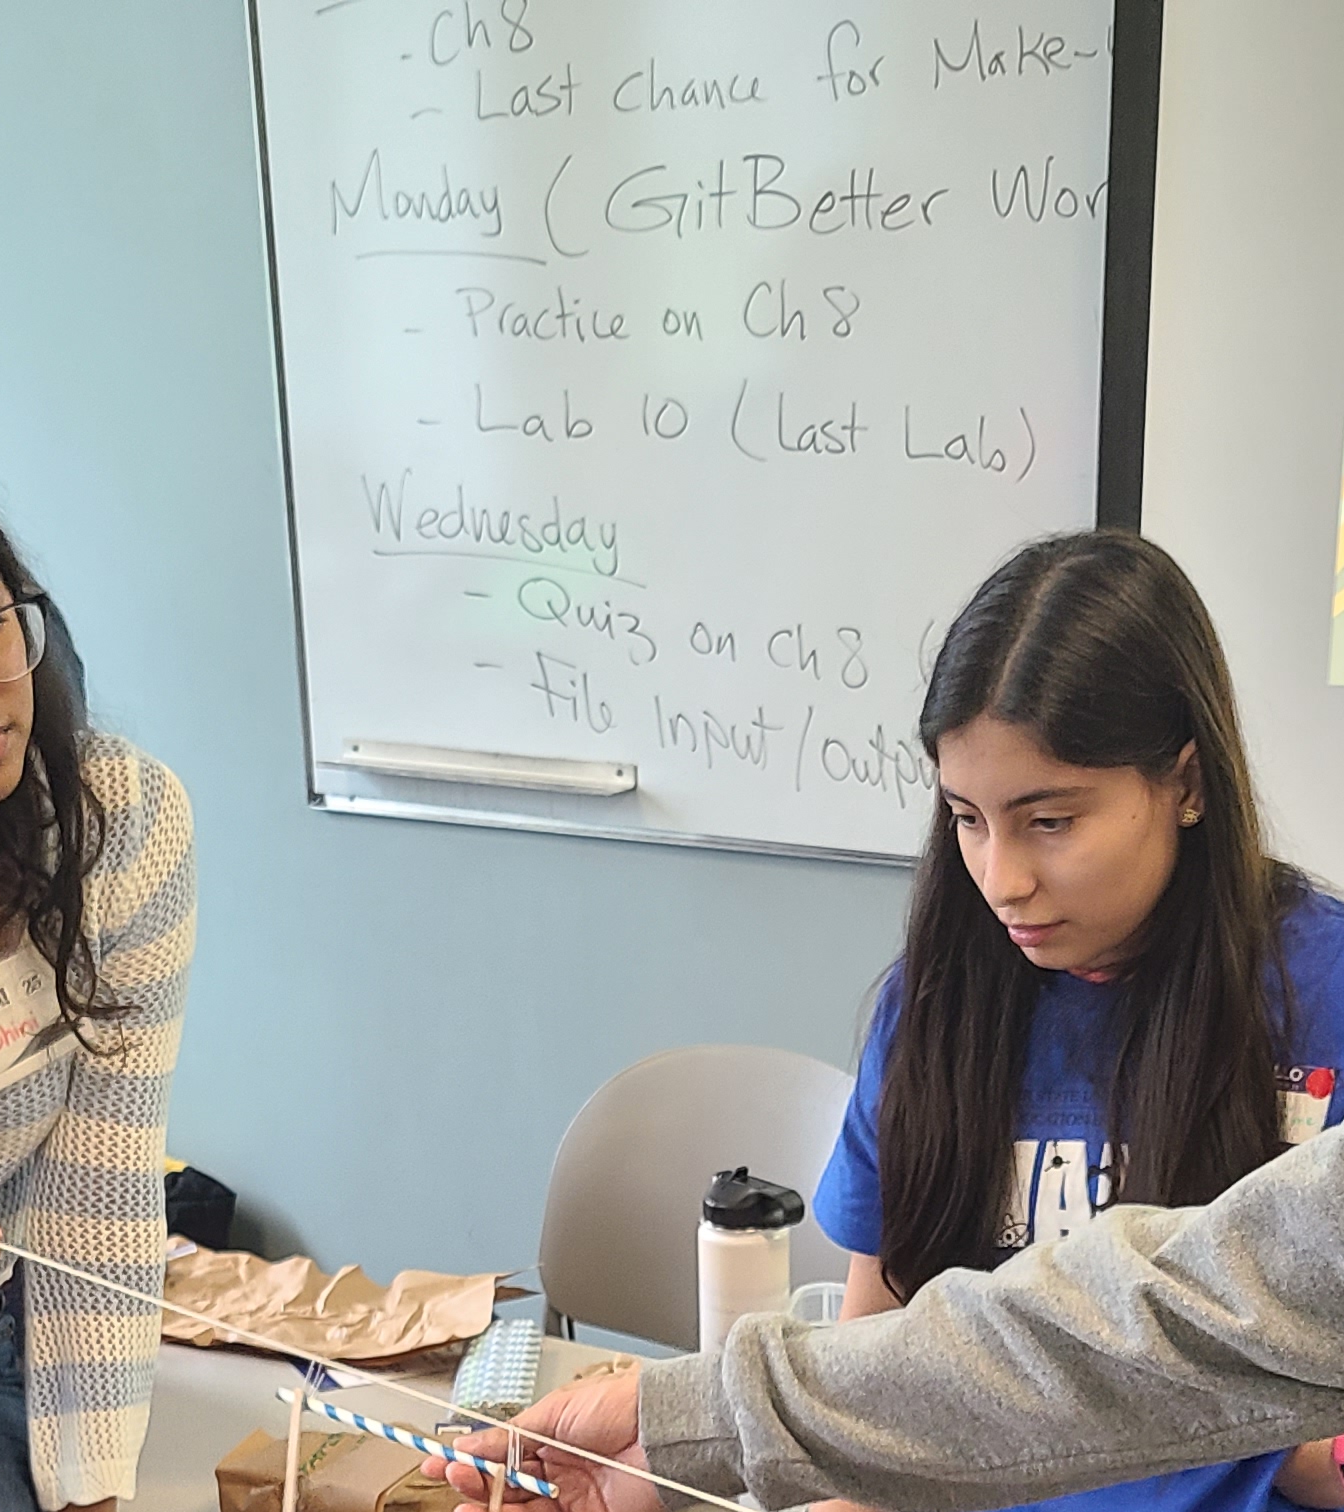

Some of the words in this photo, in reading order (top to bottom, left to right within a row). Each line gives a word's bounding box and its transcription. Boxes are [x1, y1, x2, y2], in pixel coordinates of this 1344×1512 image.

[477, 62, 581, 121] Last
[817, 18, 887, 102] for
[332, 148, 505, 238] Monday
[992, 155, 1108, 223] Wor
[455, 284, 632, 344] Practice
[662, 307, 705, 342] on
[822, 284, 860, 338] 8
[474, 383, 595, 442] Lab
[642, 393, 690, 440] 10
[358, 466, 621, 577] Wednesday
[517, 577, 658, 667] Quiz
[837, 627, 869, 690] 8
[530, 651, 617, 735] File
